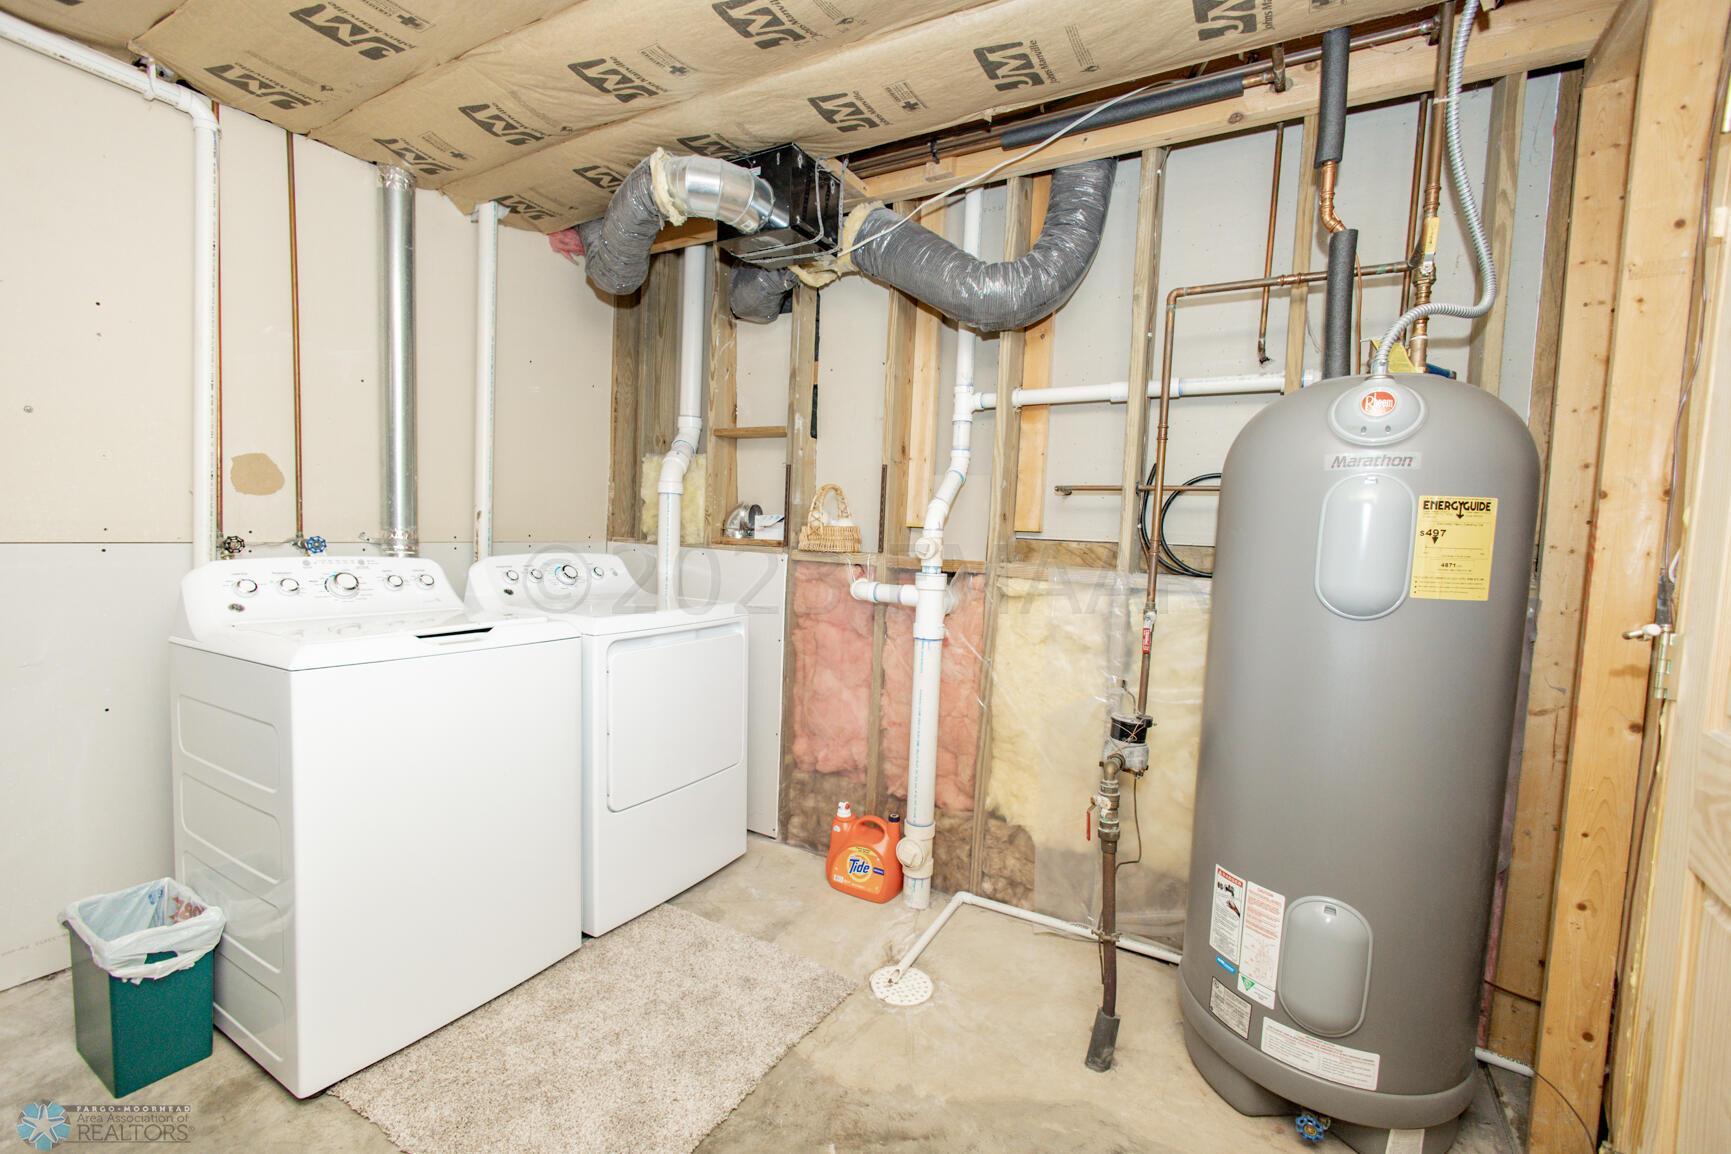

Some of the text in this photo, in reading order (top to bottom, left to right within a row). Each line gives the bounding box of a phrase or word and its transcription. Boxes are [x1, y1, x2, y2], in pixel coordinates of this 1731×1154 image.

[289, 3, 406, 61] JM
[711, 0, 807, 50] JM
[203, 64, 312, 110] JM
[567, 58, 660, 104] JM
[972, 41, 1046, 92] JM
[458, 104, 545, 146] JM
[807, 92, 881, 133] JM
[1331, 455, 1414, 469] Marathon
[1423, 500, 1492, 517] ENERGYGUIDE
[849, 858, 870, 874] Tide
